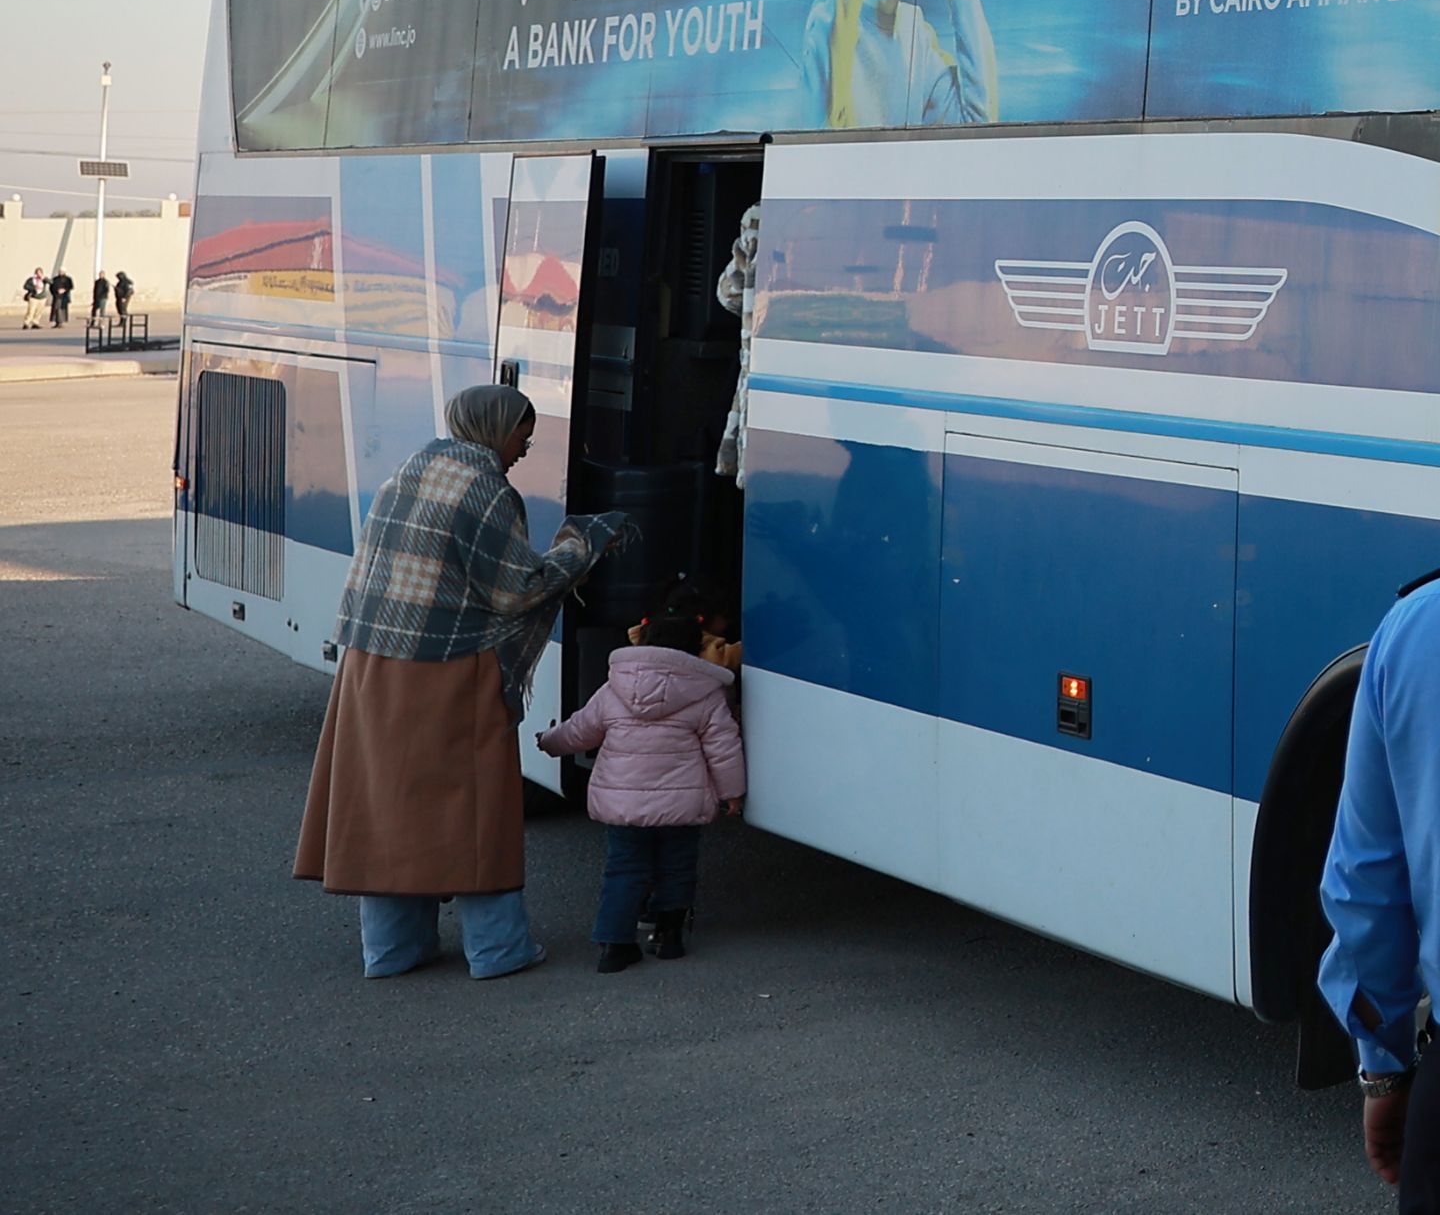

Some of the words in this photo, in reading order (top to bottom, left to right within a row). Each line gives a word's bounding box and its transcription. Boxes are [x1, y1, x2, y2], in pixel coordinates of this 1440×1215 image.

[368, 24, 416, 49] www.linc.jo
[503, 25, 520, 70] A
[527, 17, 597, 69] BANK
[602, 12, 656, 63] FOR
[665, 0, 764, 57] YOUTH
[1095, 305, 1165, 337] JETT
